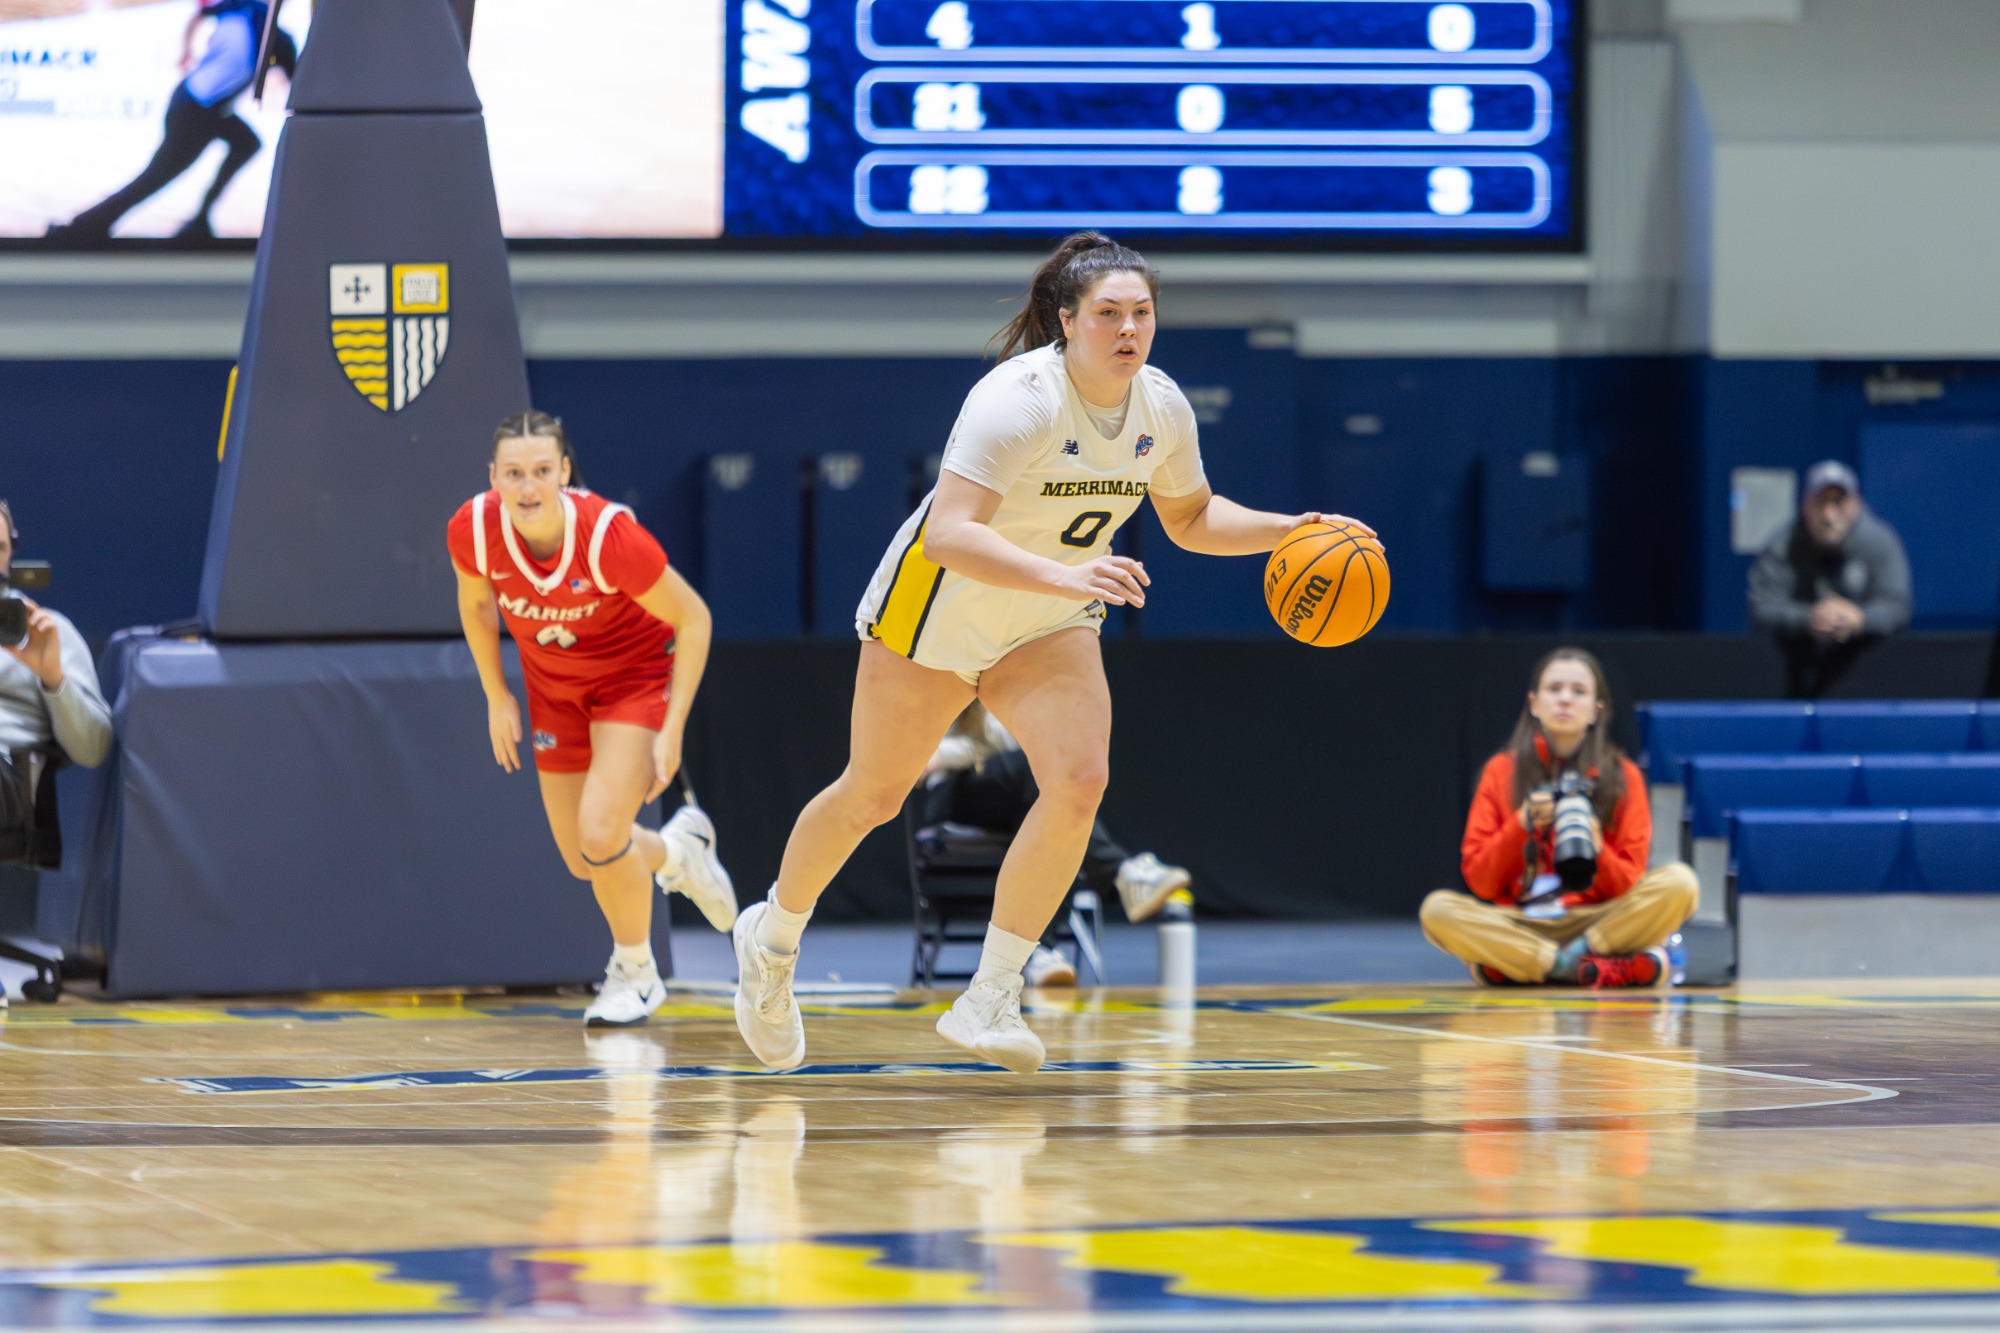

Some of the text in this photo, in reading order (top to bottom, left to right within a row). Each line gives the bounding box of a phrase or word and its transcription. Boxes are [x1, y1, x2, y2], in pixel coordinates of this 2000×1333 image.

[925, 0, 1475, 52] 4 1 0
[740, 0, 811, 163] AW
[912, 82, 987, 131] 21
[1176, 83, 1224, 133] 0
[909, 165, 1473, 215] 22 2 3
[1060, 510, 1112, 549] 0
[1285, 574, 1333, 635] Wilson
